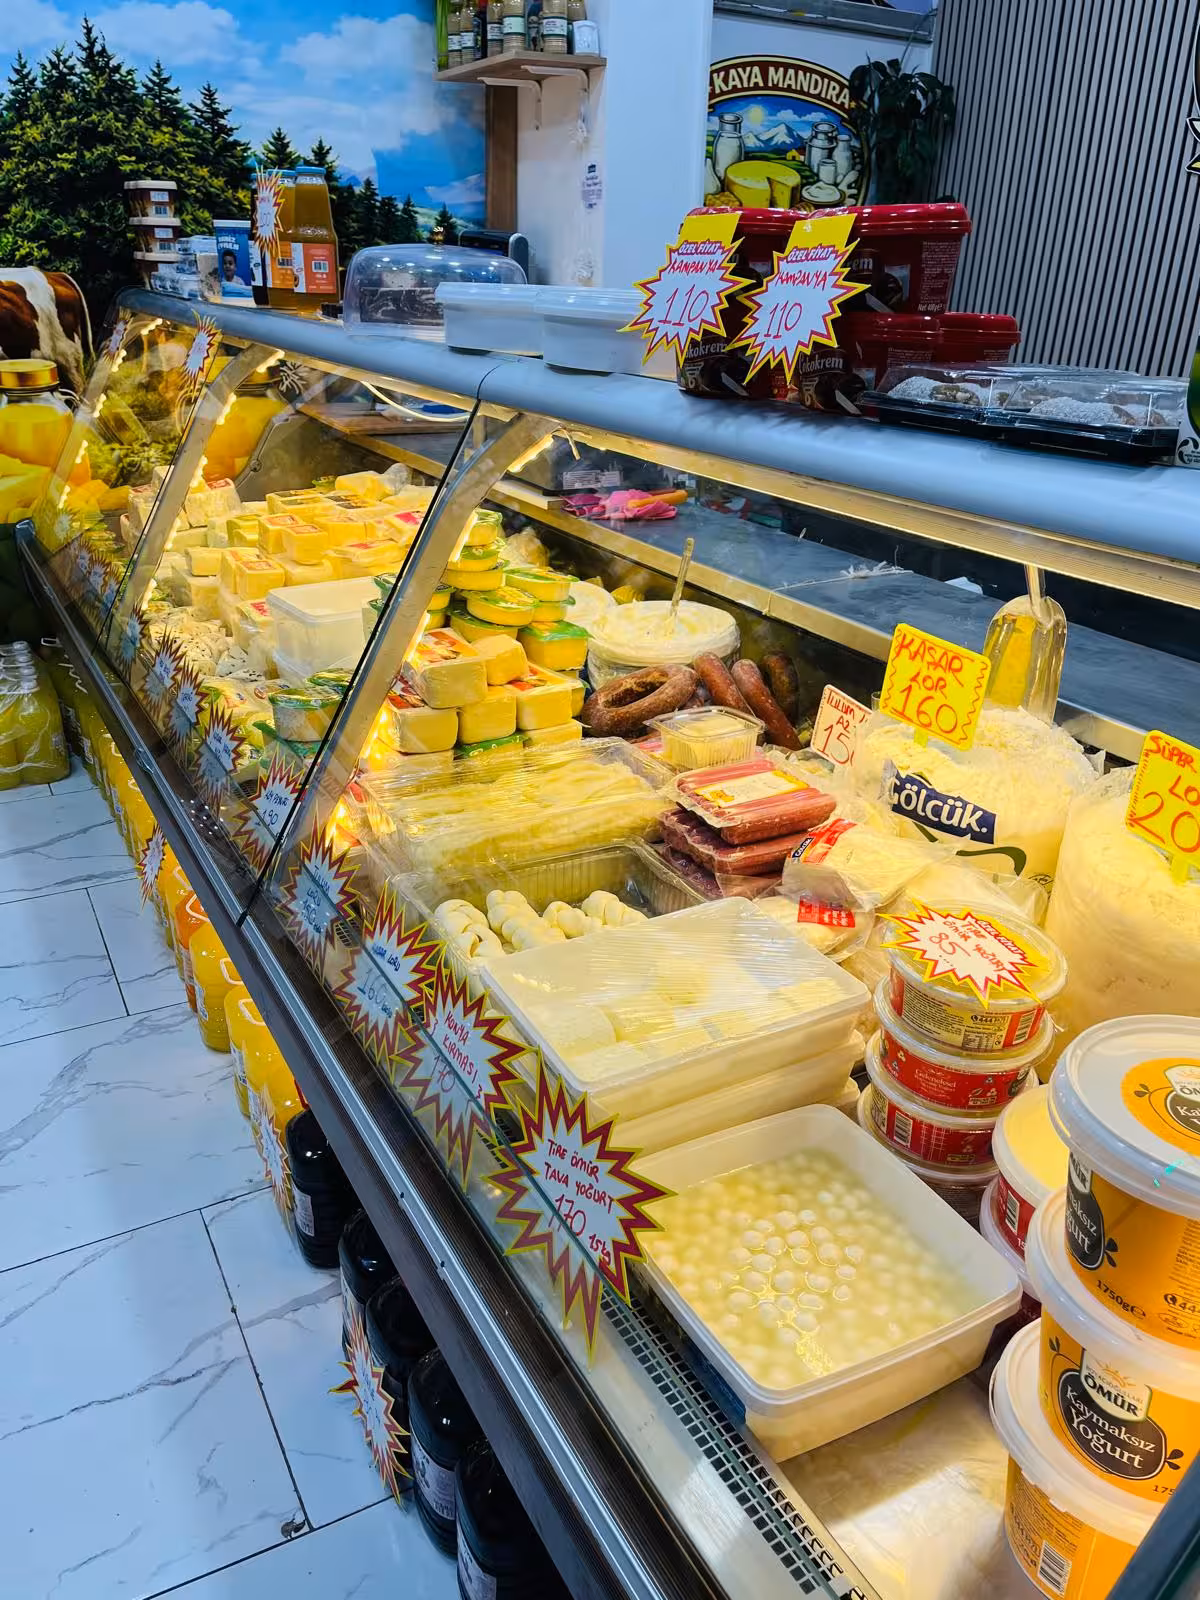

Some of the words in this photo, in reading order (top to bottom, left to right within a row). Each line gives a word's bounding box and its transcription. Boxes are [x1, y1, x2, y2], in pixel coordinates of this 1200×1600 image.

[712, 65, 764, 94] KAYA
[768, 66, 851, 109] MANDIRA
[678, 239, 697, 255] ÖZEL
[787, 246, 808, 262] ÖZEL
[658, 284, 710, 327] 110
[763, 299, 804, 340] 110
[896, 633, 965, 687] KAŞAR
[910, 671, 947, 699] LOR
[891, 683, 959, 735] 160
[817, 724, 855, 767] 15
[444, 1010, 470, 1046] KONYA
[442, 1033, 478, 1084] KIRMASI
[544, 1162, 570, 1186] TAVA
[575, 1178, 615, 1213] YOĞURT
[570, 1150, 600, 1183] ÖMÜR
[547, 1193, 588, 1238] 170
[1083, 1374, 1140, 1418] ÖMÜR
[1066, 1385, 1158, 1453] Kaymaksız
[1069, 1406, 1145, 1469] Yoğurt
